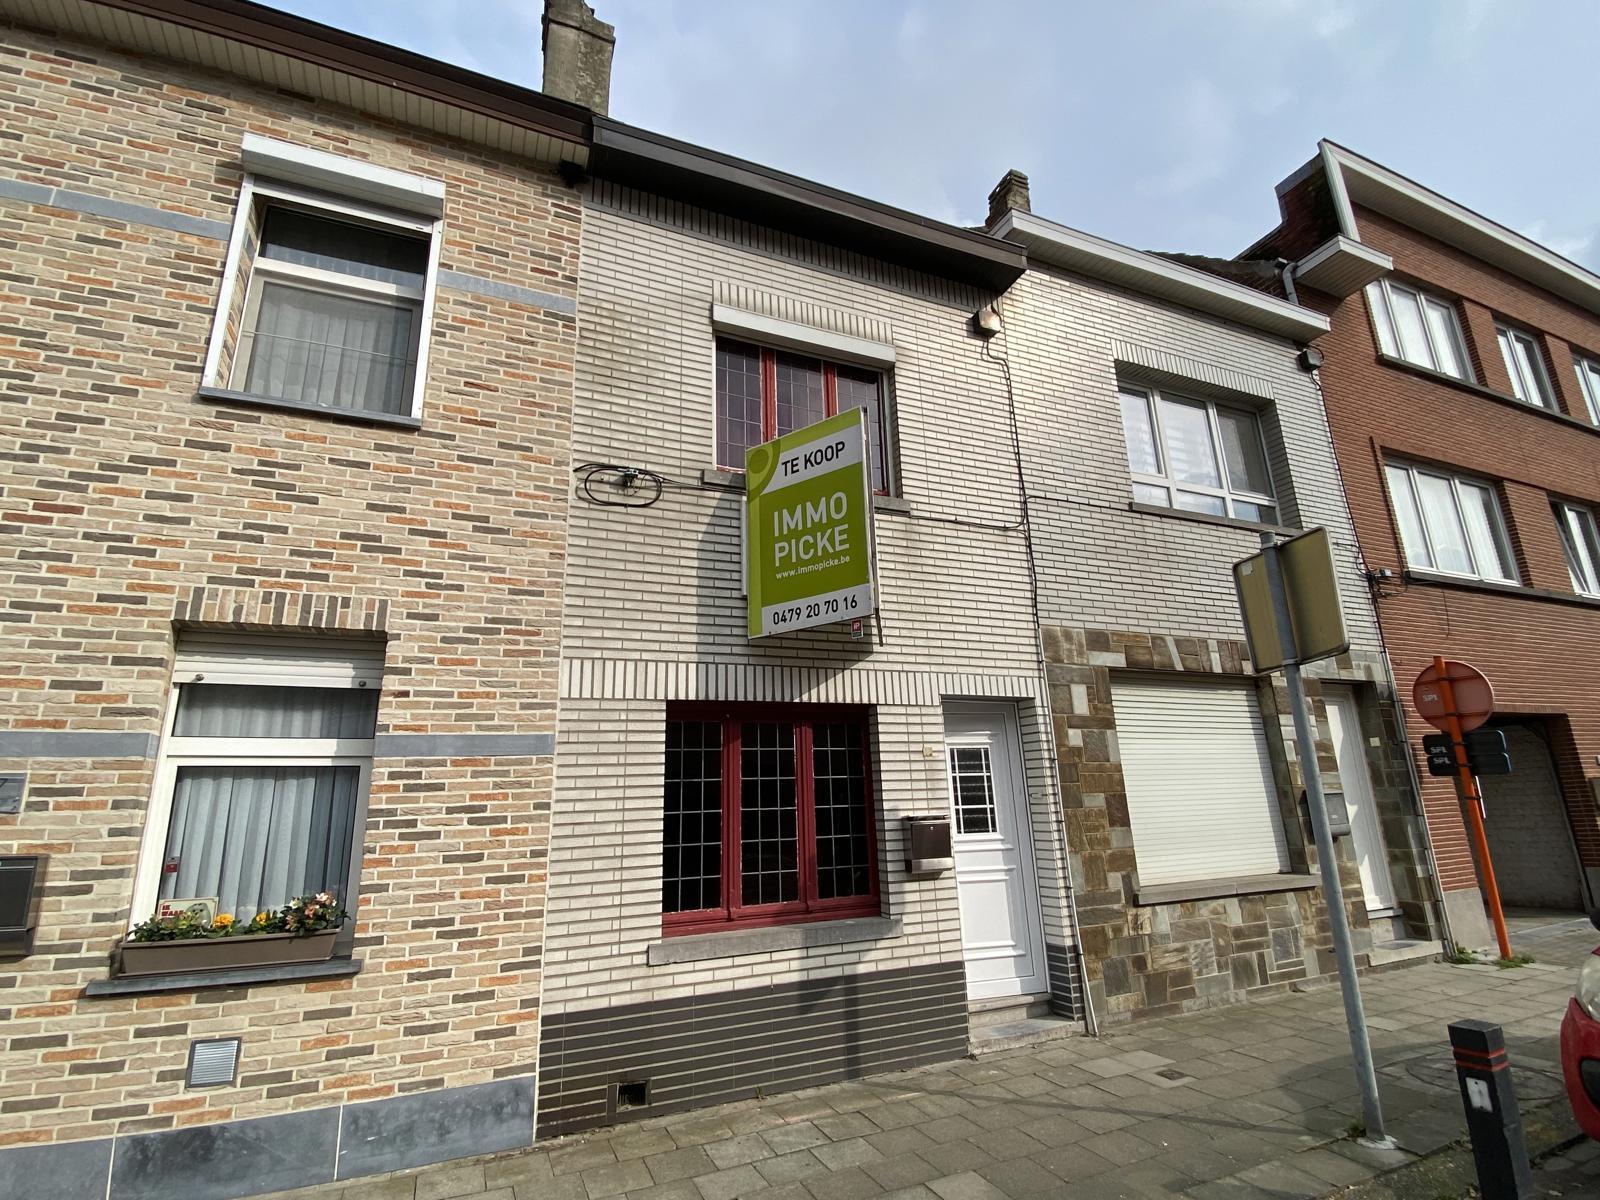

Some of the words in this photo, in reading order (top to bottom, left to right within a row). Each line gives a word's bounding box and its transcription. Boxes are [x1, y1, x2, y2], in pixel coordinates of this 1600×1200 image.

[781, 457, 799, 477] TE
[804, 441, 845, 470] KOOP
[774, 491, 847, 537] IMMO
[774, 523, 849, 567] PICKE
[775, 555, 850, 579] www.immopicke.be
[772, 607, 801, 625] 0479
[806, 603, 820, 618] 20
[824, 599, 838, 614] 70
[843, 594, 858, 610] 16
